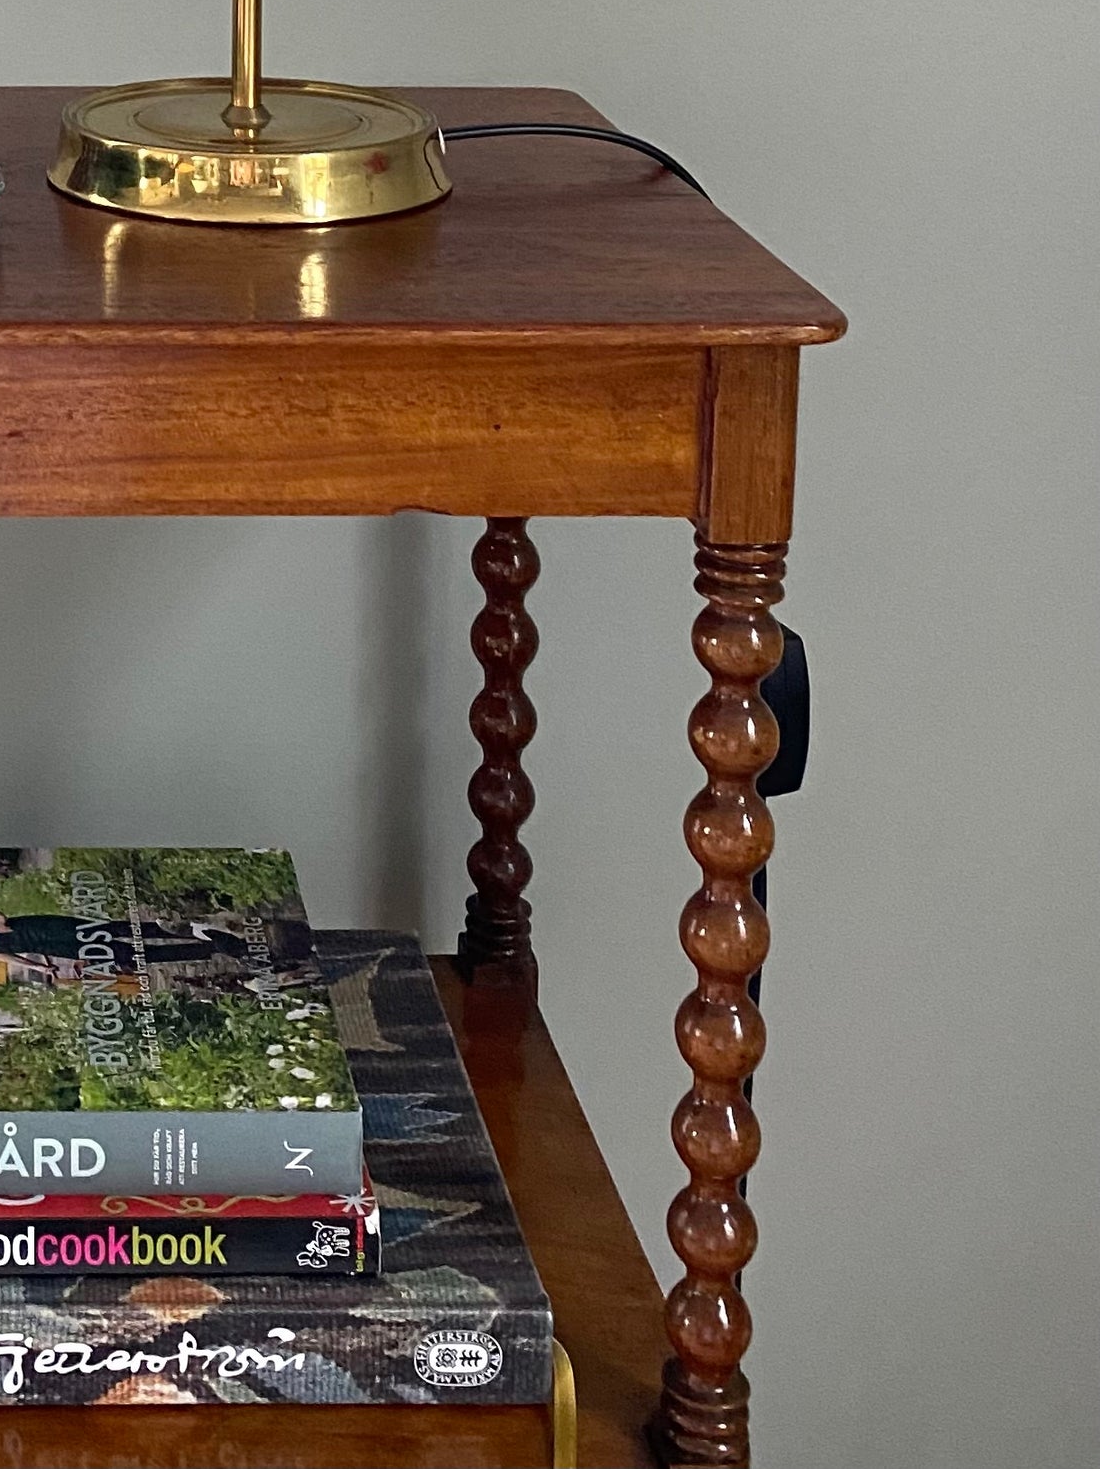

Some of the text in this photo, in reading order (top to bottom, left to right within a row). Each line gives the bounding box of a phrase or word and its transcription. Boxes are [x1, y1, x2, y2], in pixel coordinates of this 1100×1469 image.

[66, 870, 130, 1068] BYGGNADSVÅRD
[132, 954, 148, 974] kraft
[242, 916, 284, 1010] ERIKA ÅBERG
